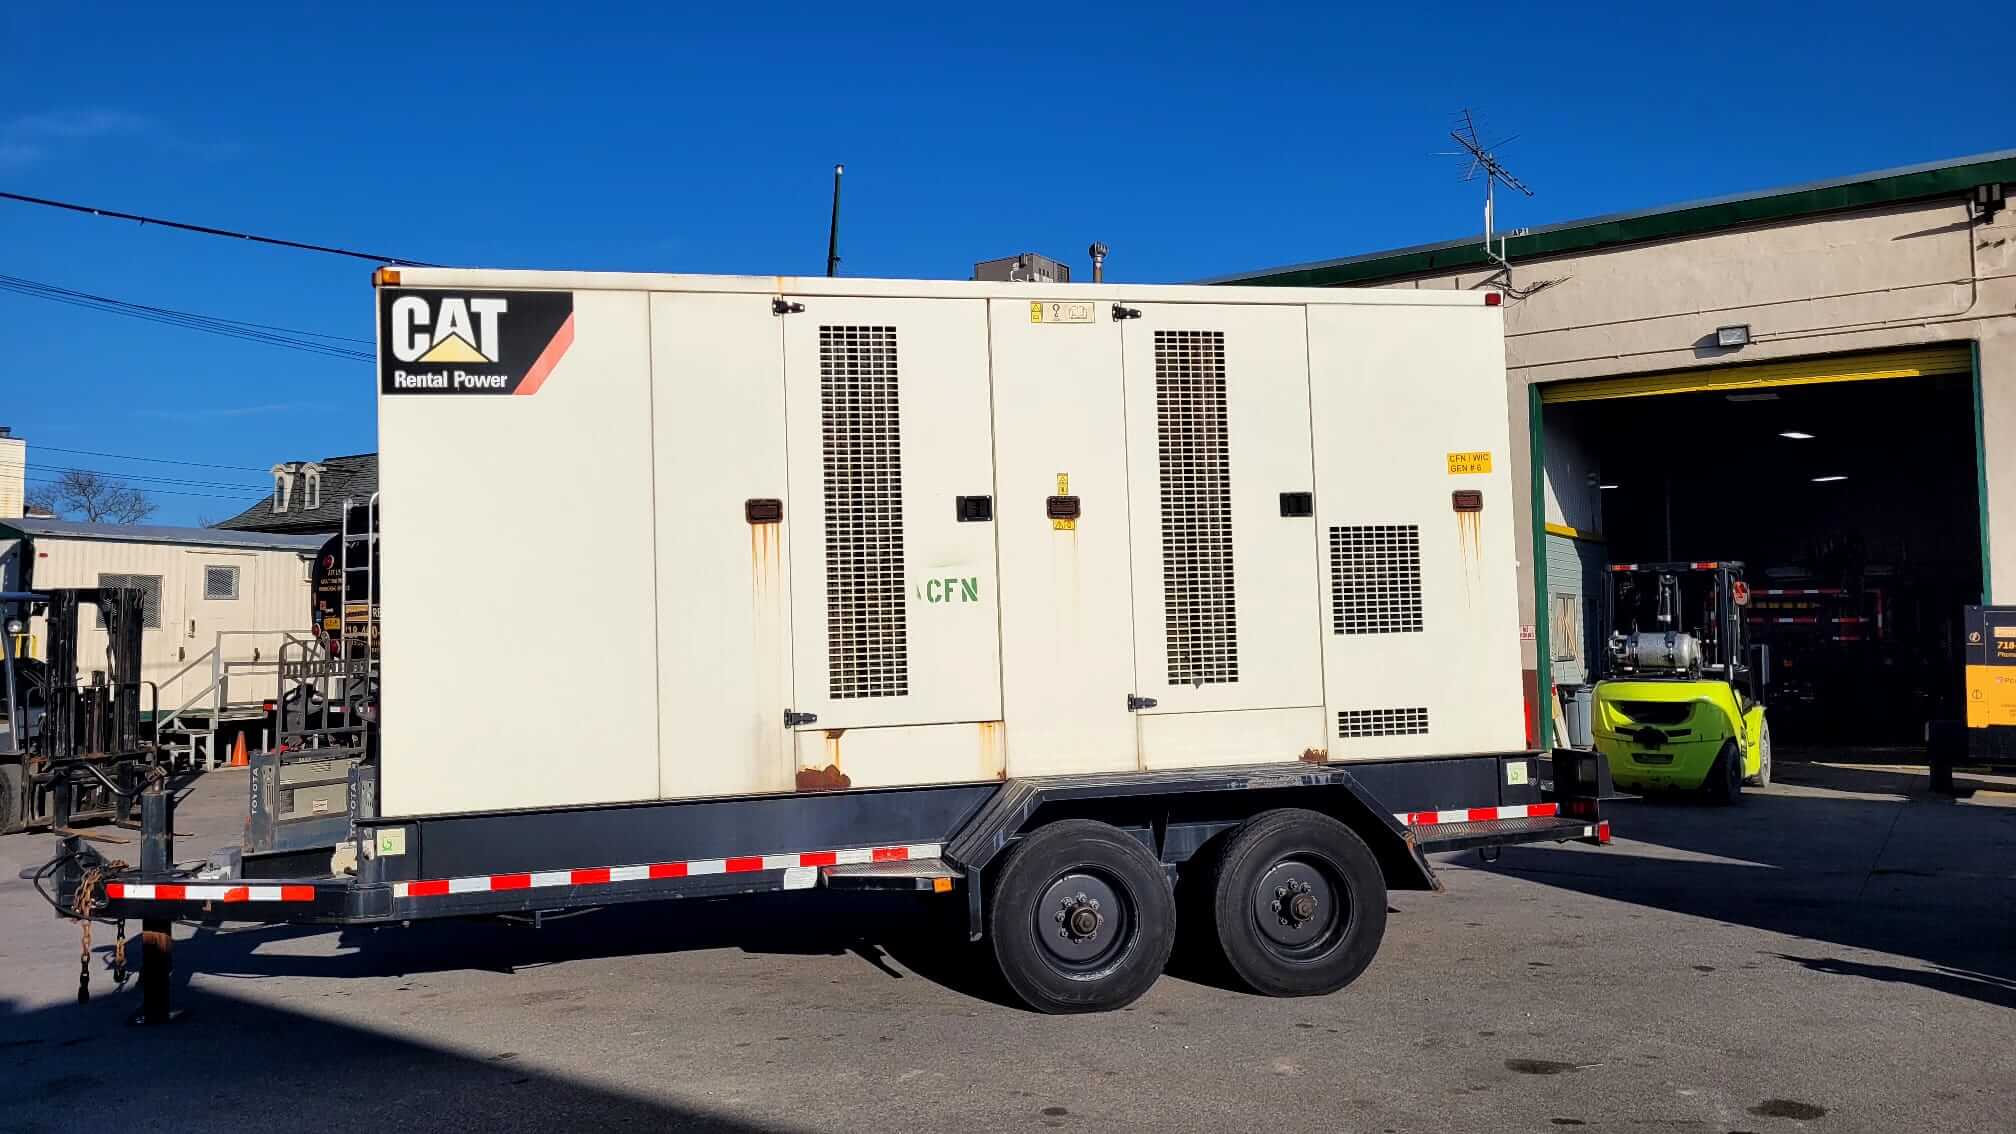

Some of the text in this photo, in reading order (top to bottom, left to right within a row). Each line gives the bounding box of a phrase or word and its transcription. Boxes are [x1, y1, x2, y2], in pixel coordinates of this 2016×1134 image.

[392, 296, 507, 362] CAT
[395, 371, 507, 388] Rental Power
[1450, 464, 1467, 473] GEN
[926, 577, 978, 603] CFN
[251, 767, 260, 814] TOYOTA
